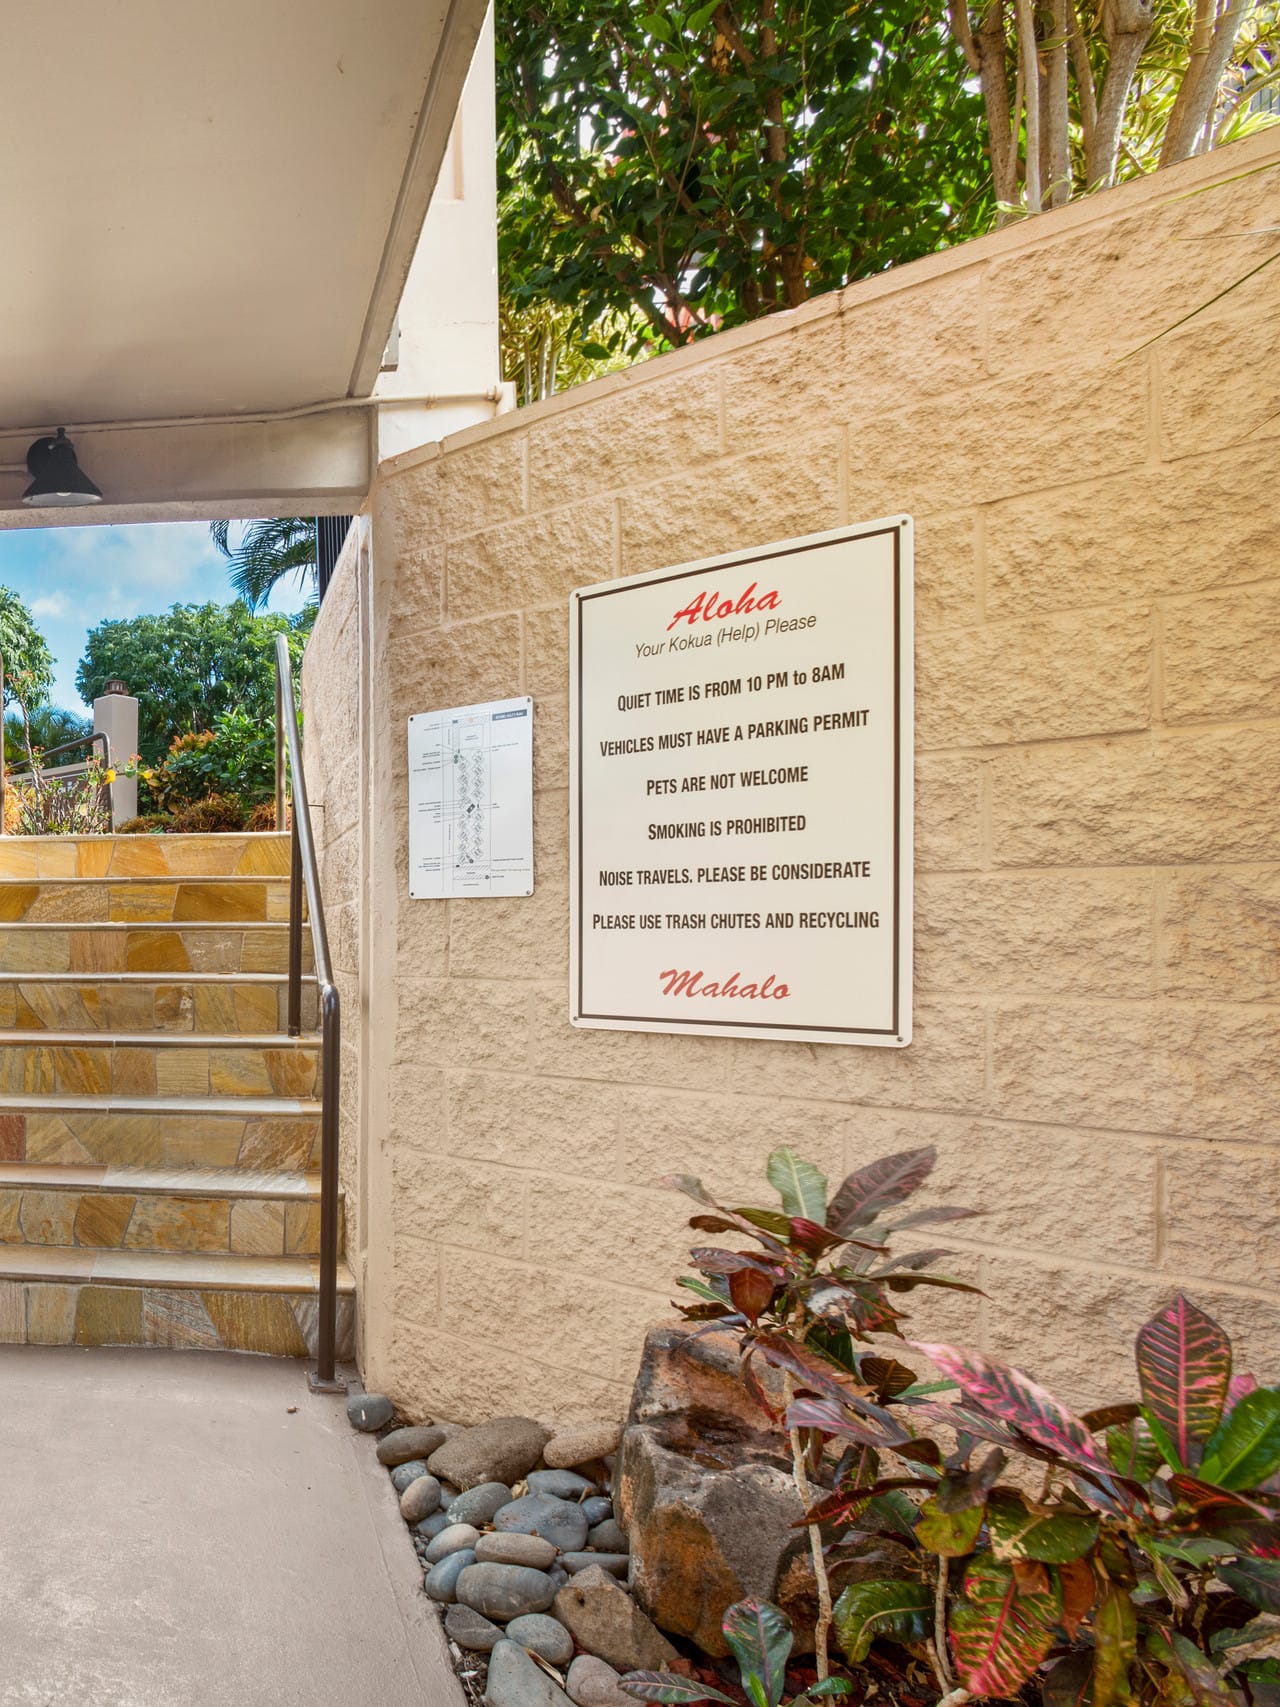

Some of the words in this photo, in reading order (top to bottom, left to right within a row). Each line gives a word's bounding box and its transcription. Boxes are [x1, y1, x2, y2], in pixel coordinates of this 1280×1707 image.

[666, 582, 782, 631] Aloha
[636, 643, 665, 658] Your
[669, 633, 712, 653] Kokua
[717, 623, 759, 646] (Help)
[765, 616, 816, 635] Please
[618, 693, 651, 712] QUIET
[655, 688, 684, 705] TIME
[689, 685, 700, 700] IS
[705, 679, 741, 698] FROM
[747, 676, 761, 692] 10
[767, 672, 787, 689] PM
[793, 671, 806, 685] to
[812, 663, 844, 682] 8AM
[600, 737, 654, 756] VEHICLES
[659, 732, 692, 749] MUST
[697, 727, 729, 745] HAVE
[734, 726, 743, 741] A
[748, 718, 808, 739] PARKING
[814, 710, 869, 731] PERMIT
[647, 779, 677, 795] PETS
[682, 776, 705, 792] ARE
[711, 773, 736, 789] NOT
[740, 766, 808, 787] WELCOME
[649, 822, 705, 840] SMOKING
[711, 821, 721, 836] IS
[727, 815, 805, 835] PROHIBITED
[600, 871, 632, 886] NOISE
[637, 869, 692, 884] TRAVELS.
[698, 867, 745, 882] PLEASE
[751, 866, 767, 881] BE
[772, 861, 870, 880] CONSIDERATE
[593, 914, 635, 929] PLEASE
[640, 915, 661, 929] USE
[666, 914, 705, 929] TRASH
[711, 913, 760, 928] CHUTES
[766, 913, 793, 928] AND
[800, 912, 879, 928] RECYCLING
[660, 969, 790, 999] Mahalo
